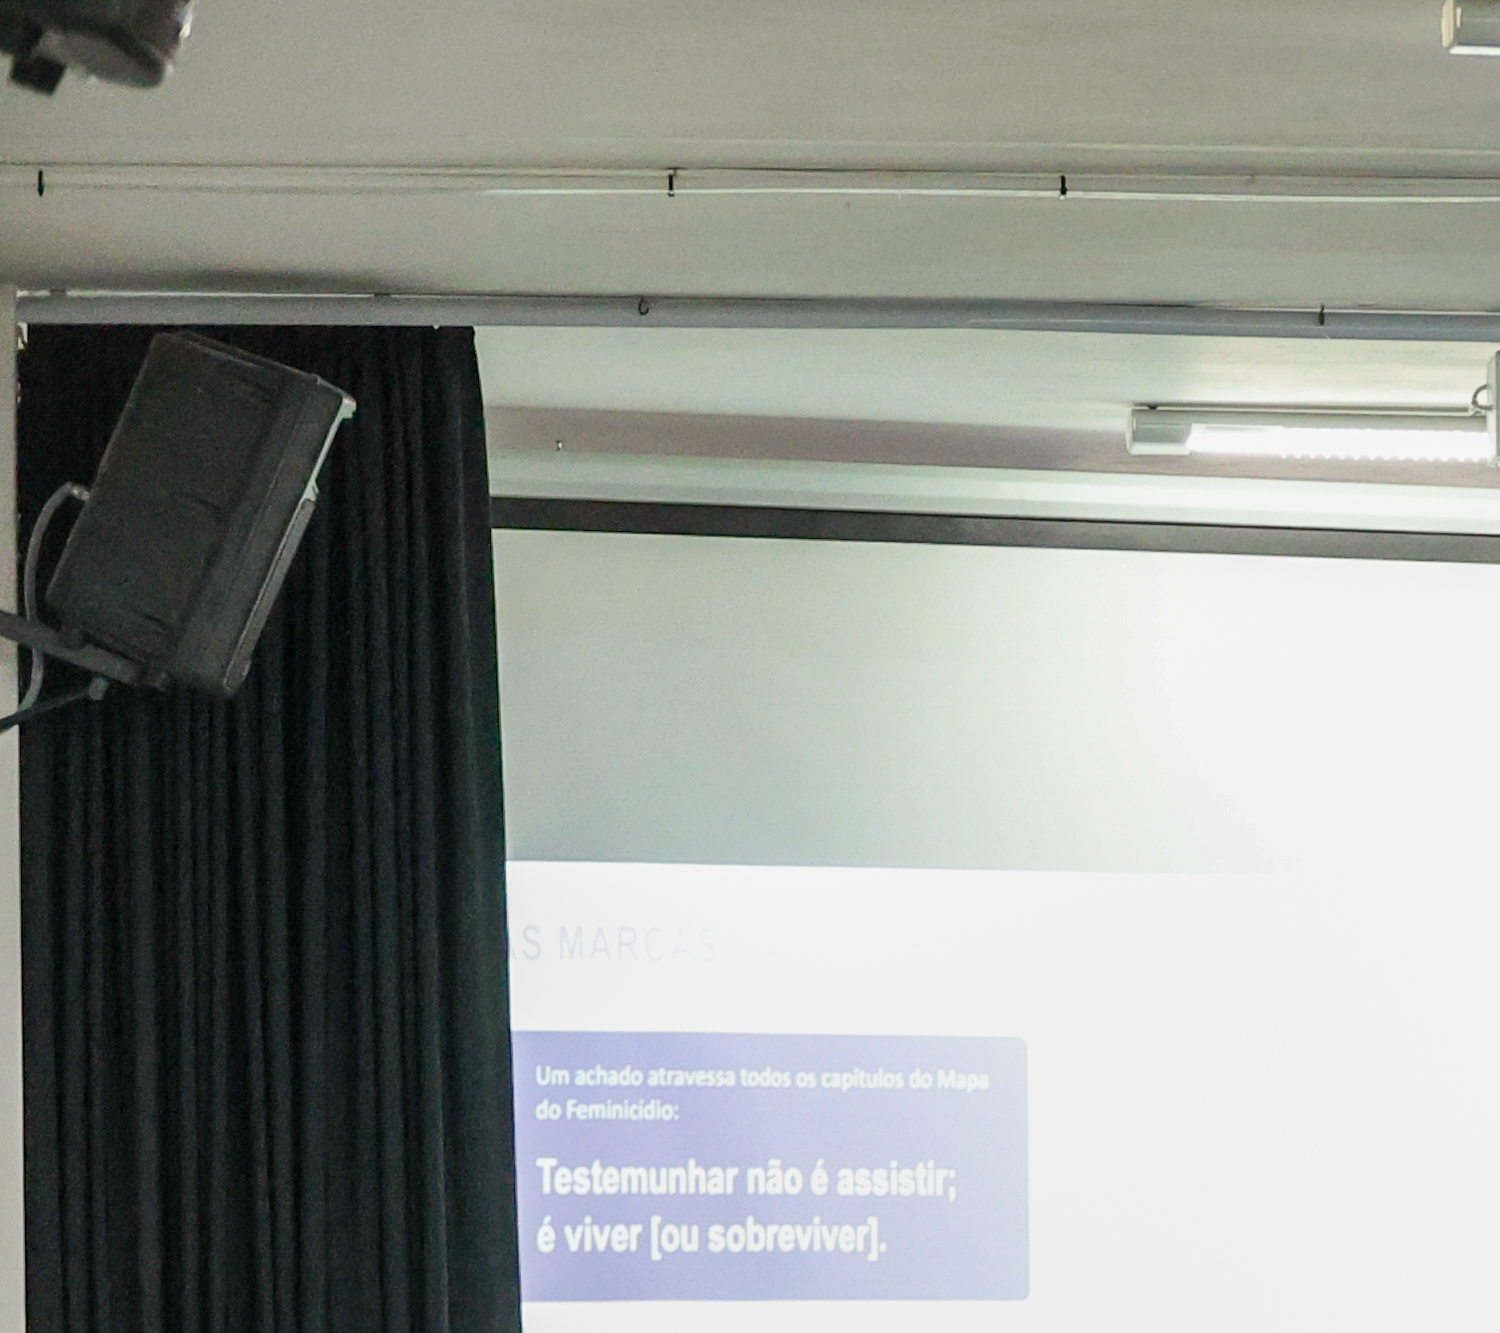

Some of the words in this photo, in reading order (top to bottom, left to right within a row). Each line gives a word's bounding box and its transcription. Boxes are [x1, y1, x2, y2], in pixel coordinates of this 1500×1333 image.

[535, 1065, 569, 1086] Um
[574, 1066, 643, 1087] achado
[647, 1067, 736, 1087] atravessa
[740, 1067, 791, 1088] todos
[796, 1071, 817, 1088] os
[908, 1069, 933, 1090] do
[937, 1069, 989, 1093] Mapa
[535, 1099, 561, 1120] do
[566, 1099, 680, 1120] Feminicídio:
[536, 1158, 739, 1195] Testemunhar
[746, 1159, 802, 1195] não
[811, 1159, 829, 1196] é
[837, 1160, 956, 1202] assistir;
[536, 1216, 556, 1253] é
[564, 1218, 643, 1252] viver
[650, 1215, 698, 1261] [ou
[707, 1216, 886, 1261] sobreviver].
